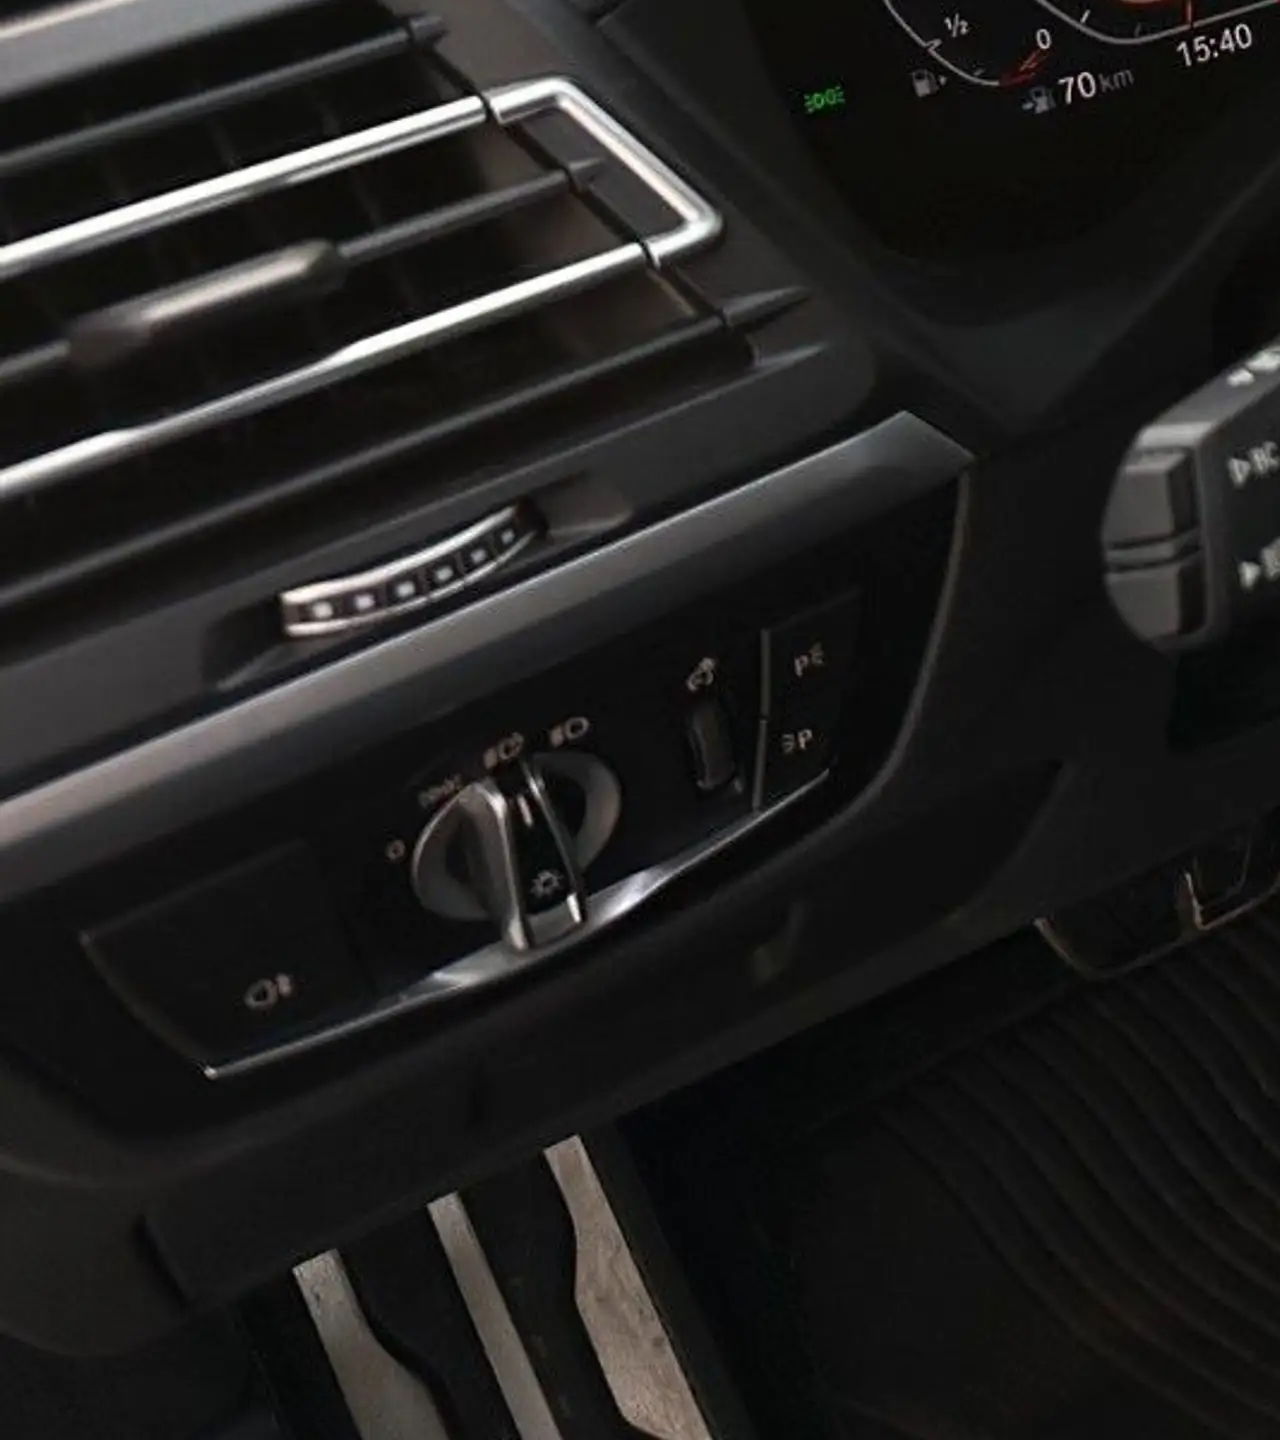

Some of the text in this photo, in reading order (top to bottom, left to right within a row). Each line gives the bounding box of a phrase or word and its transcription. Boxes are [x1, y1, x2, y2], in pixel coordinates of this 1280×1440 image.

[1036, 28, 1051, 50] 0
[1176, 22, 1253, 67] 15:40
[1058, 68, 1136, 105] 70 km
